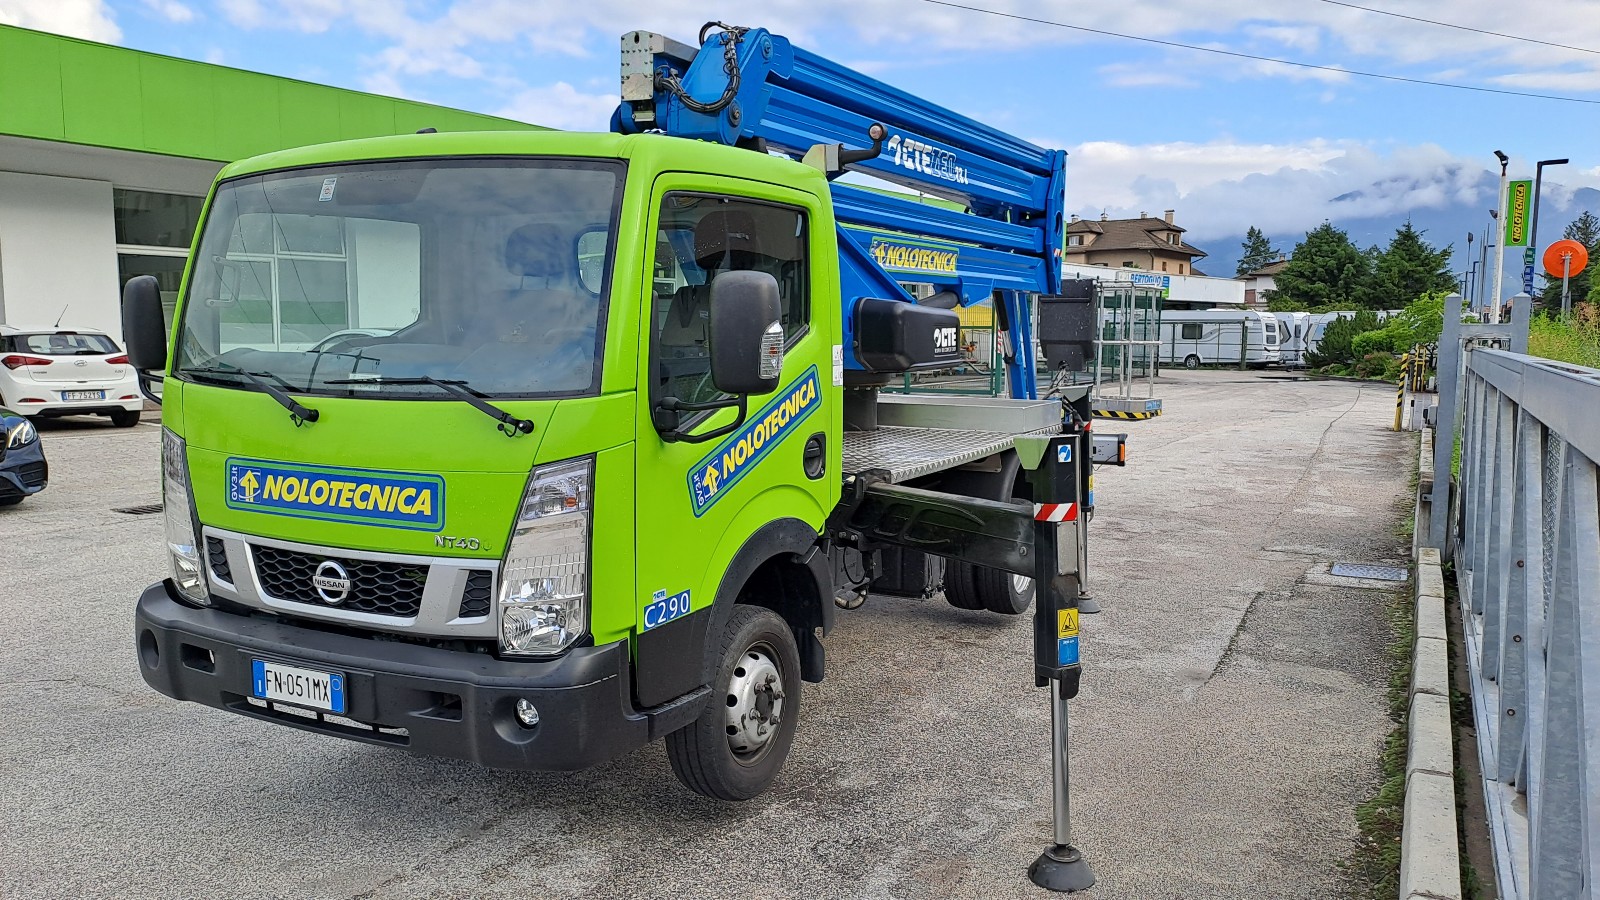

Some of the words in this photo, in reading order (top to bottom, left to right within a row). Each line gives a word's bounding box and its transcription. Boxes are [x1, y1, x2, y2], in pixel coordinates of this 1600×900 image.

[1513, 186, 1525, 239] NOLOTECNICA
[886, 246, 957, 272] NOLOTECNICA
[941, 327, 956, 347] CTE
[723, 379, 815, 480] NOLOTECNICA
[263, 475, 431, 516] NOLOTECNICA
[314, 578, 345, 589] NISSAN
[644, 592, 689, 628] C290
